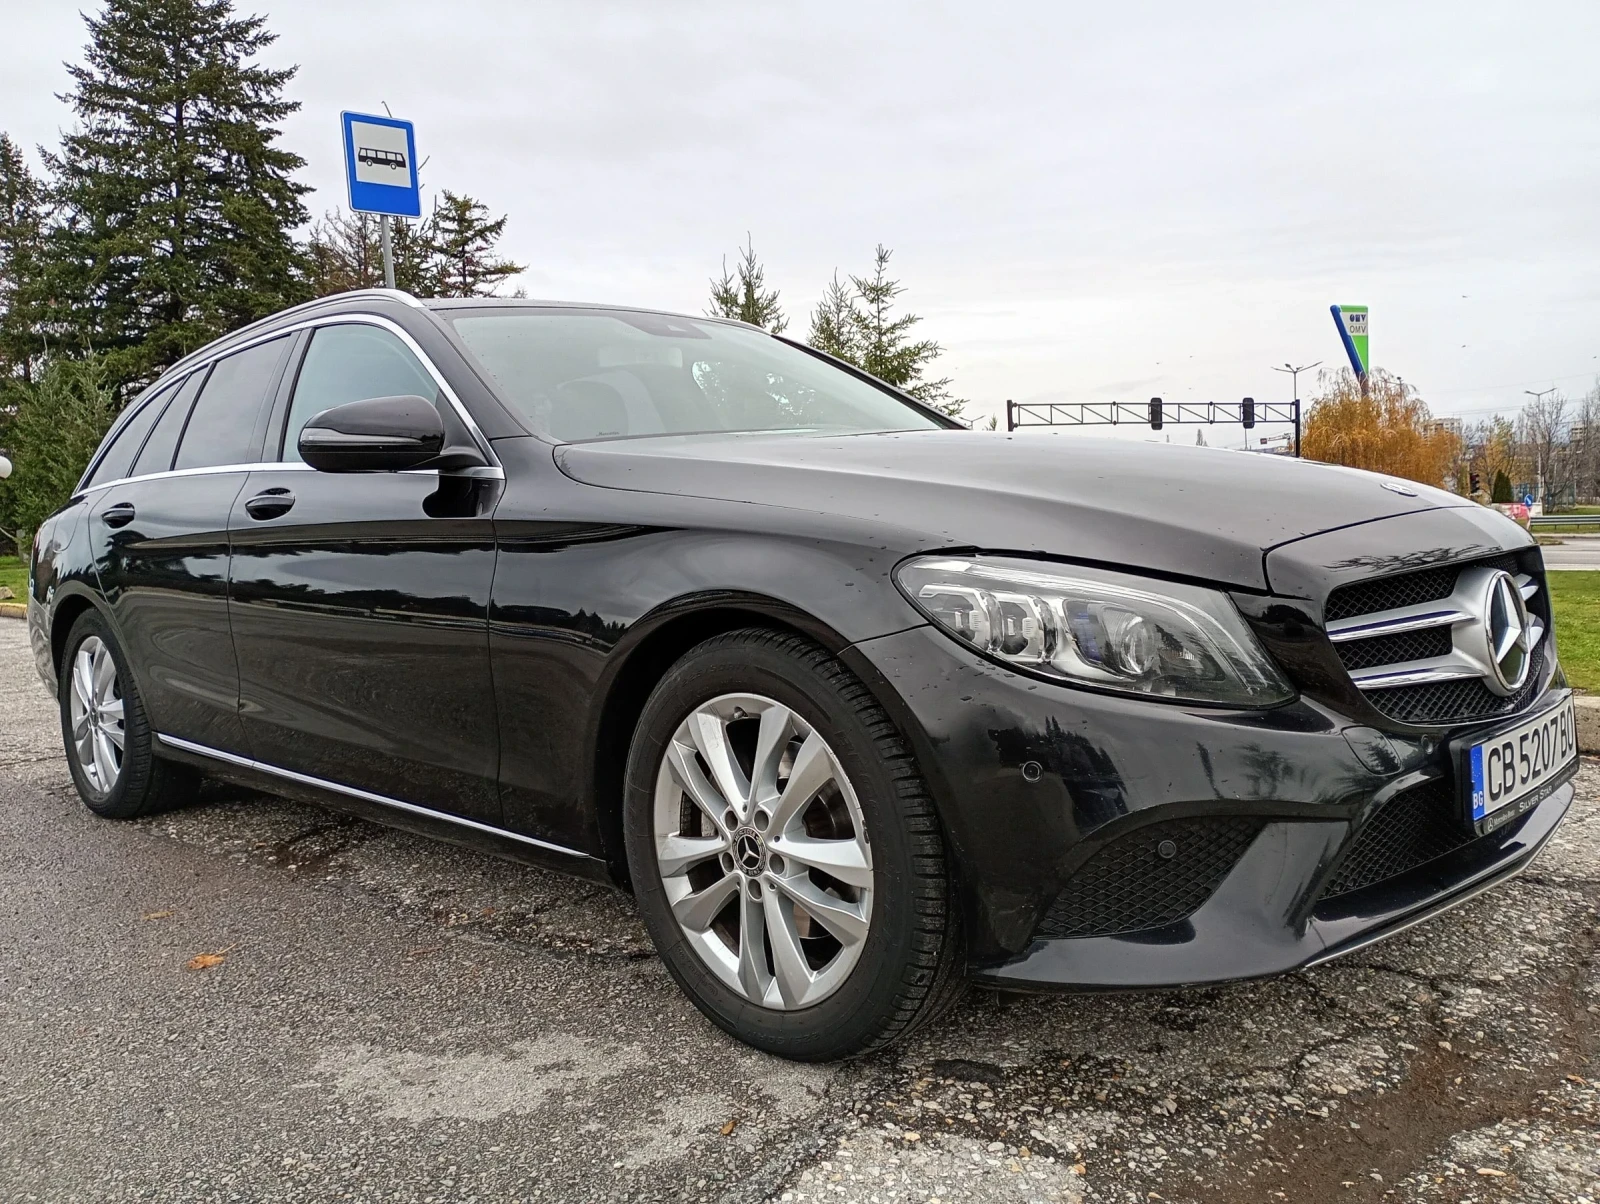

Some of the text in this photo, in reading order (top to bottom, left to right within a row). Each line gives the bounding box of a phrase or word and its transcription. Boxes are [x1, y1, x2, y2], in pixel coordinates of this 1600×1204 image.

[1349, 313, 1366, 322] OMV
[1349, 325, 1366, 334] OMV
[1487, 705, 1574, 802] CB 5207 BO
[1473, 791, 1484, 809] BG
